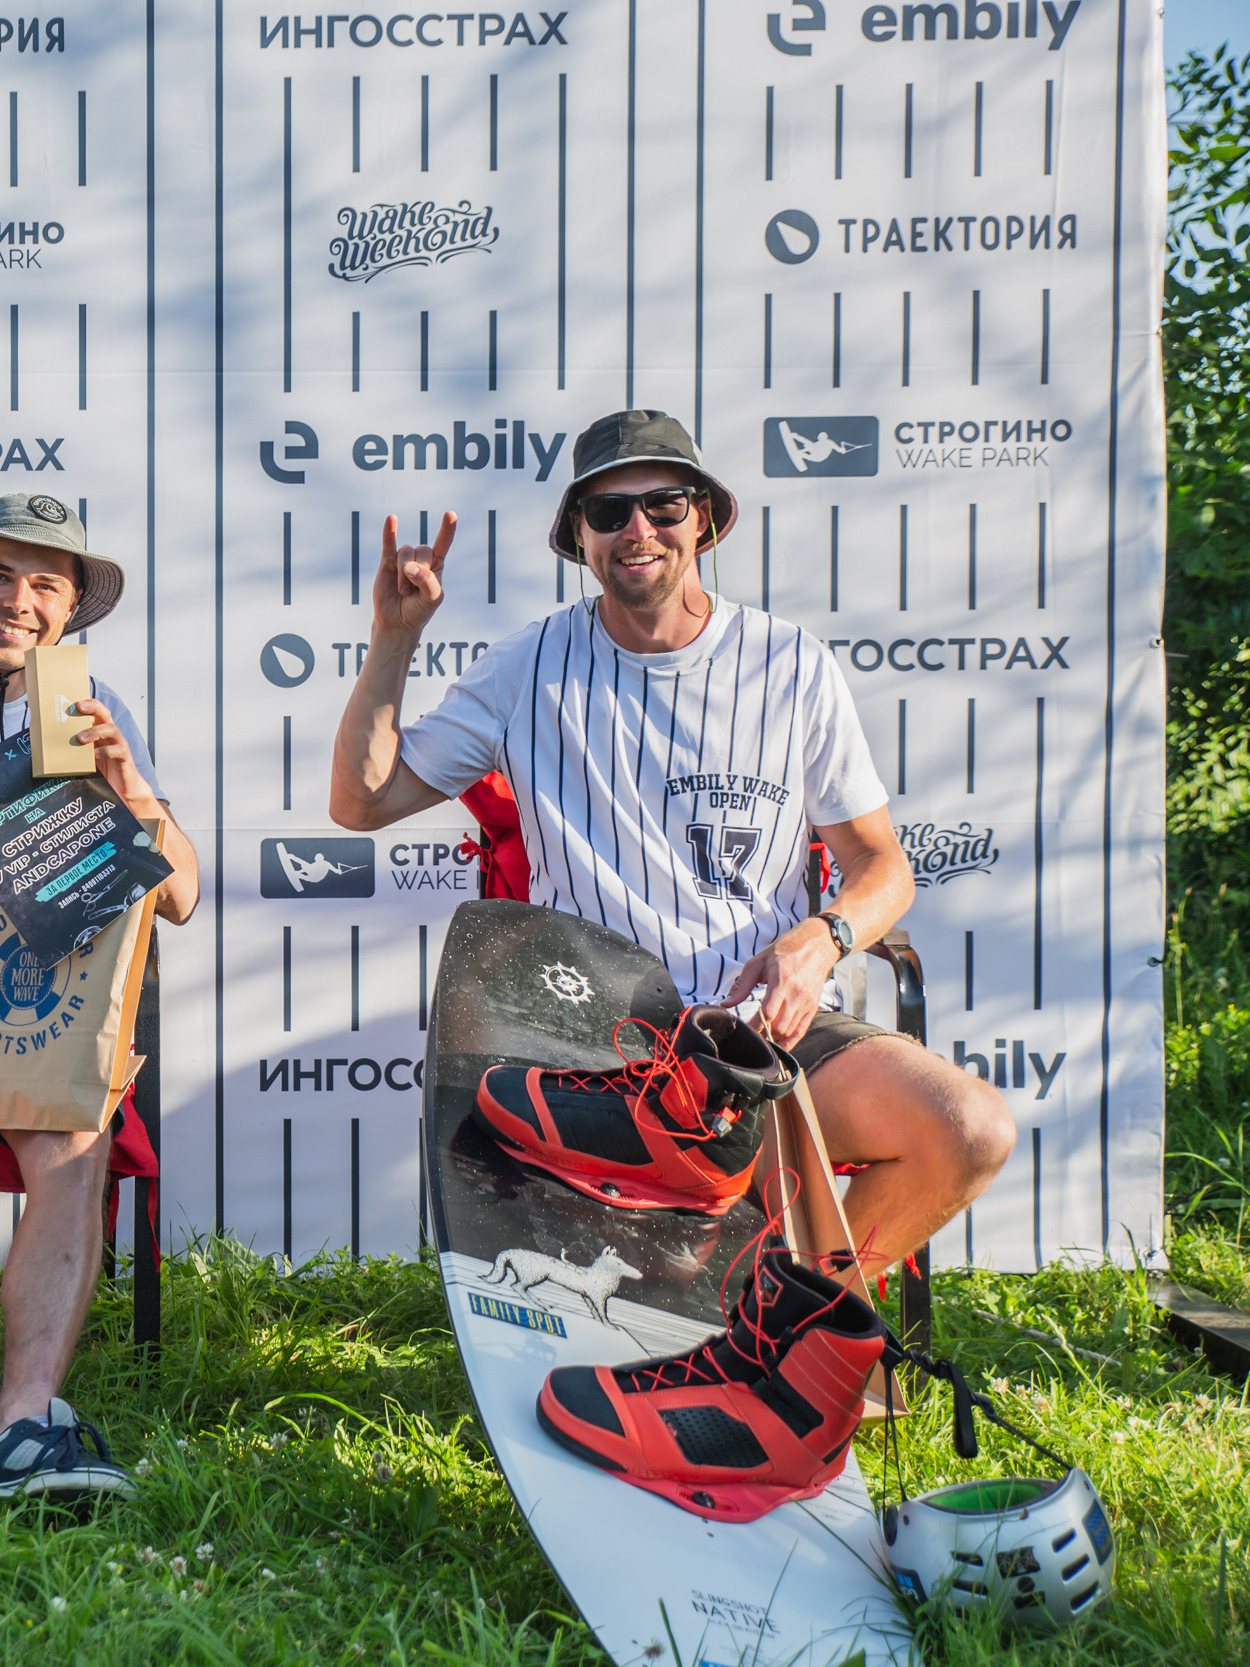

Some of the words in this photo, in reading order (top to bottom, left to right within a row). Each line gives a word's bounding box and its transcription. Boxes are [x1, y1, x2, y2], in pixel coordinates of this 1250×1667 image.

[260, 12, 568, 48] ИНГОССТРАХ
[861, 0, 1082, 51] embily
[838, 214, 1076, 253] ТРАЕКТОРИЯ
[895, 418, 1073, 442] СТРОГИНО
[352, 418, 567, 482] embily
[895, 448, 972, 468] WAKE
[982, 447, 1049, 467] PARK
[827, 637, 1070, 671] ГОССТРАХ
[666, 773, 738, 796] EMBILY
[742, 776, 790, 806] WAKE
[710, 791, 751, 811] OPEN
[2, 797, 83, 857] СТРИЖКУ
[24, 807, 46, 824] НА
[0, 853, 31, 876] VIP
[39, 800, 116, 856] СТИЛИСТА
[12, 817, 117, 895] ANDCAPONE
[45, 883, 57, 896] ЗА
[56, 866, 83, 889] ПЕРВОЕ
[81, 849, 107, 871] МЕСТО
[392, 870, 468, 890] WAKE
[686, 823, 762, 902] 17
[11, 968, 45, 986] MORE
[13, 986, 40, 1002] WAVE
[954, 1038, 1067, 1099] bily
[471, 1294, 521, 1324] FAMILY
[526, 1309, 562, 1335] SPOT
[691, 1600, 780, 1633] NATIVE
